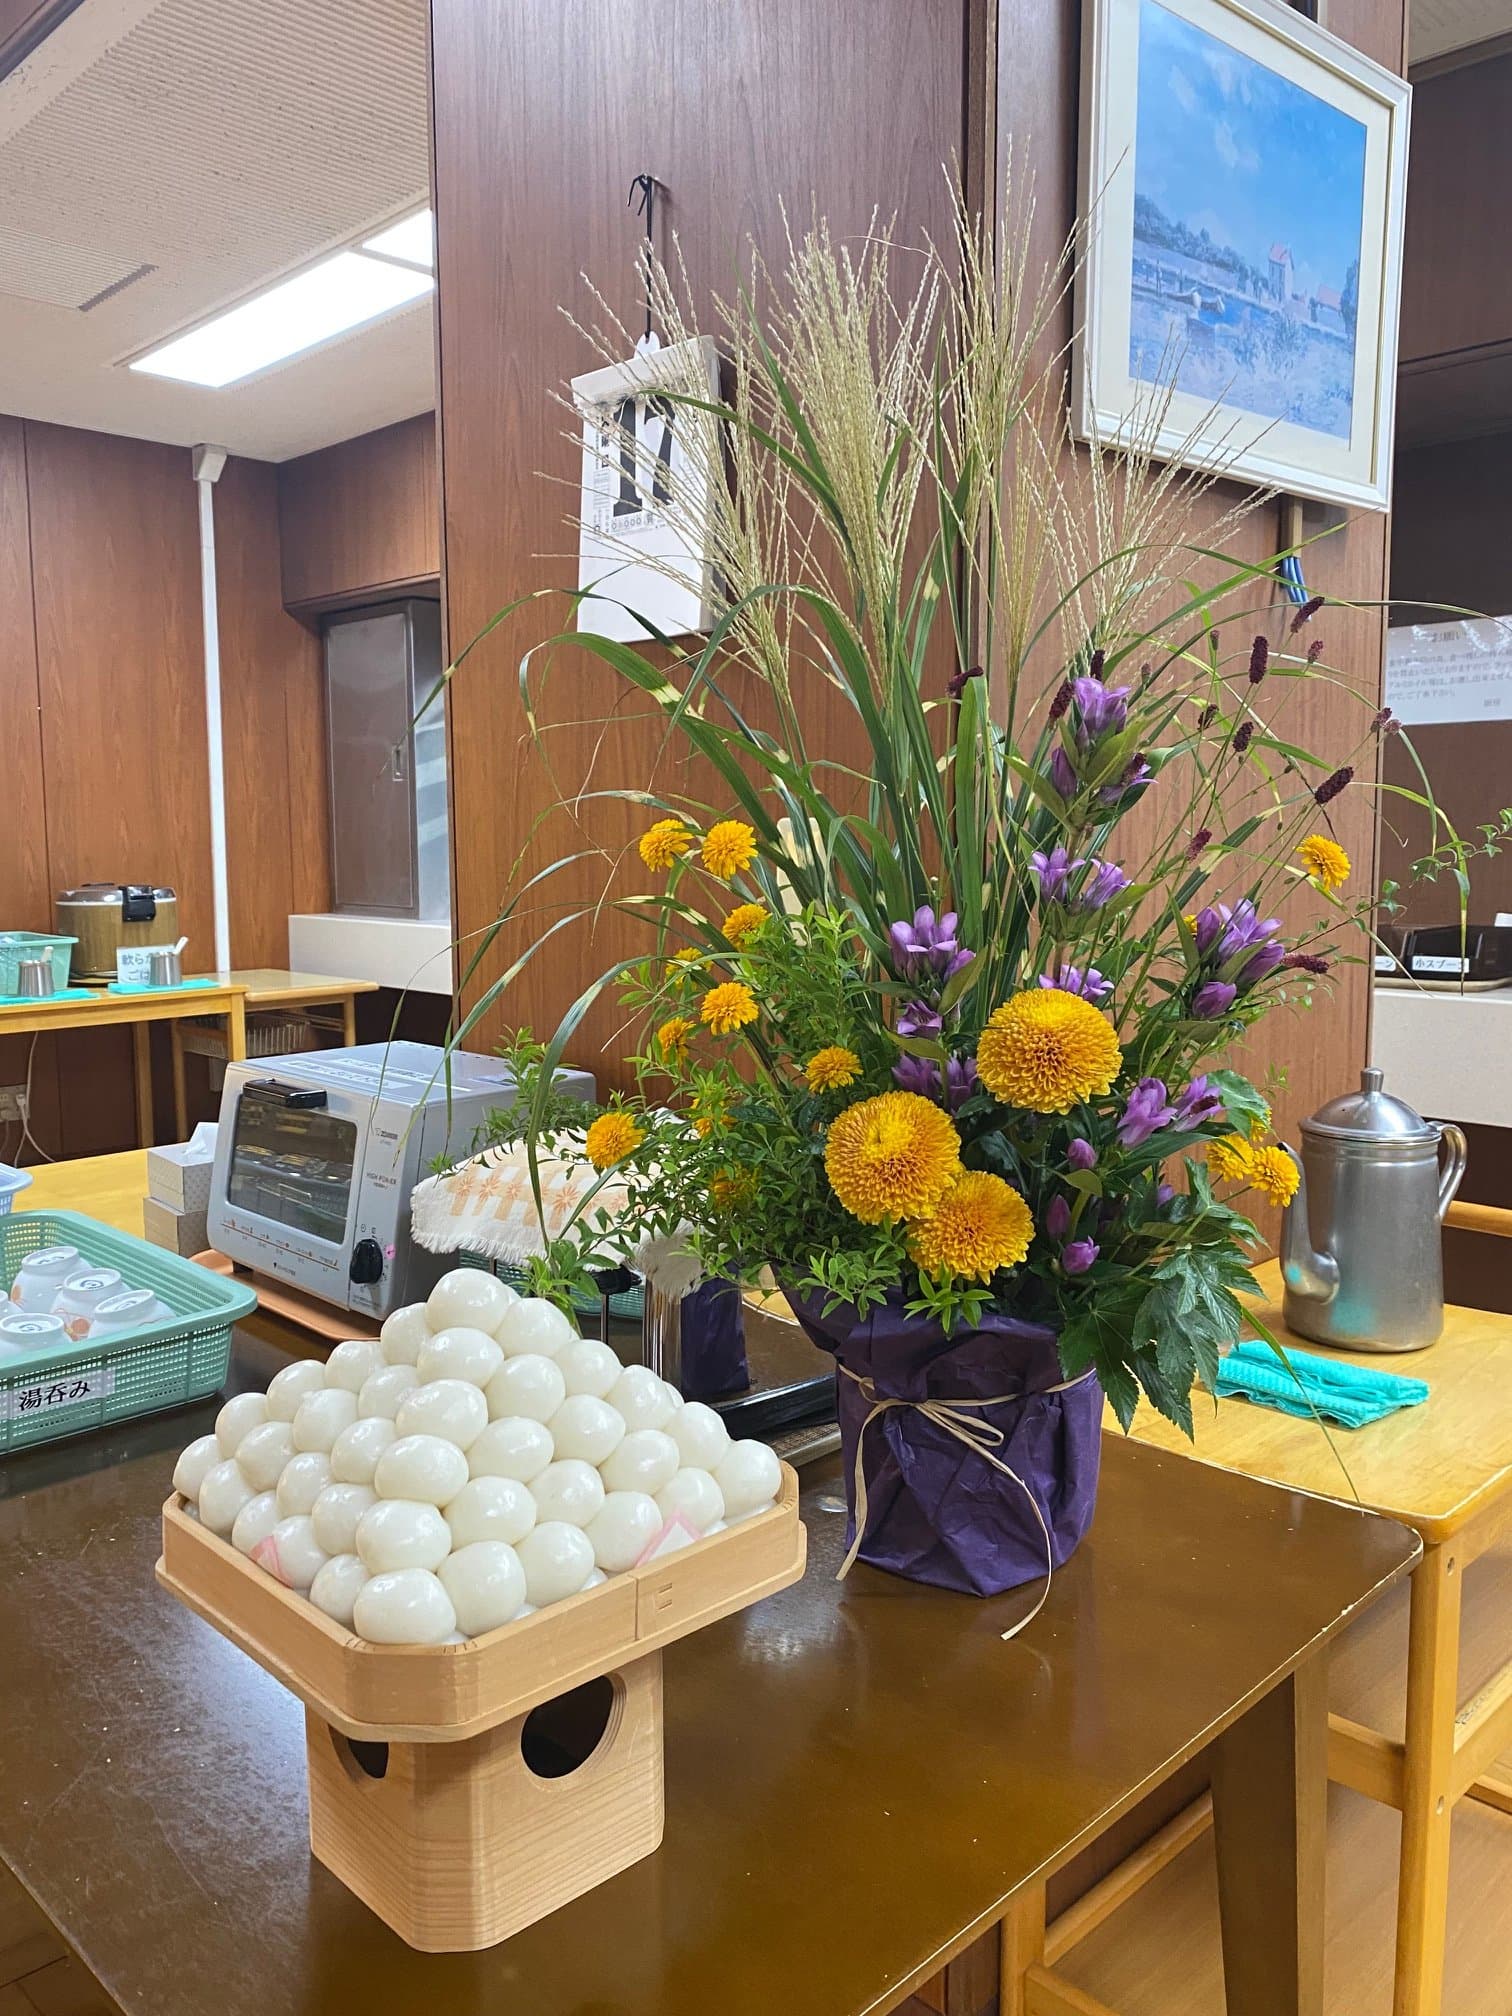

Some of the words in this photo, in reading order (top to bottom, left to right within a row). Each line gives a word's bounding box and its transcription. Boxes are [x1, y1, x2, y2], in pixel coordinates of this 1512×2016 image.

[613, 394, 675, 517] 17
[19, 1380, 91, 1411] 湯呑み
